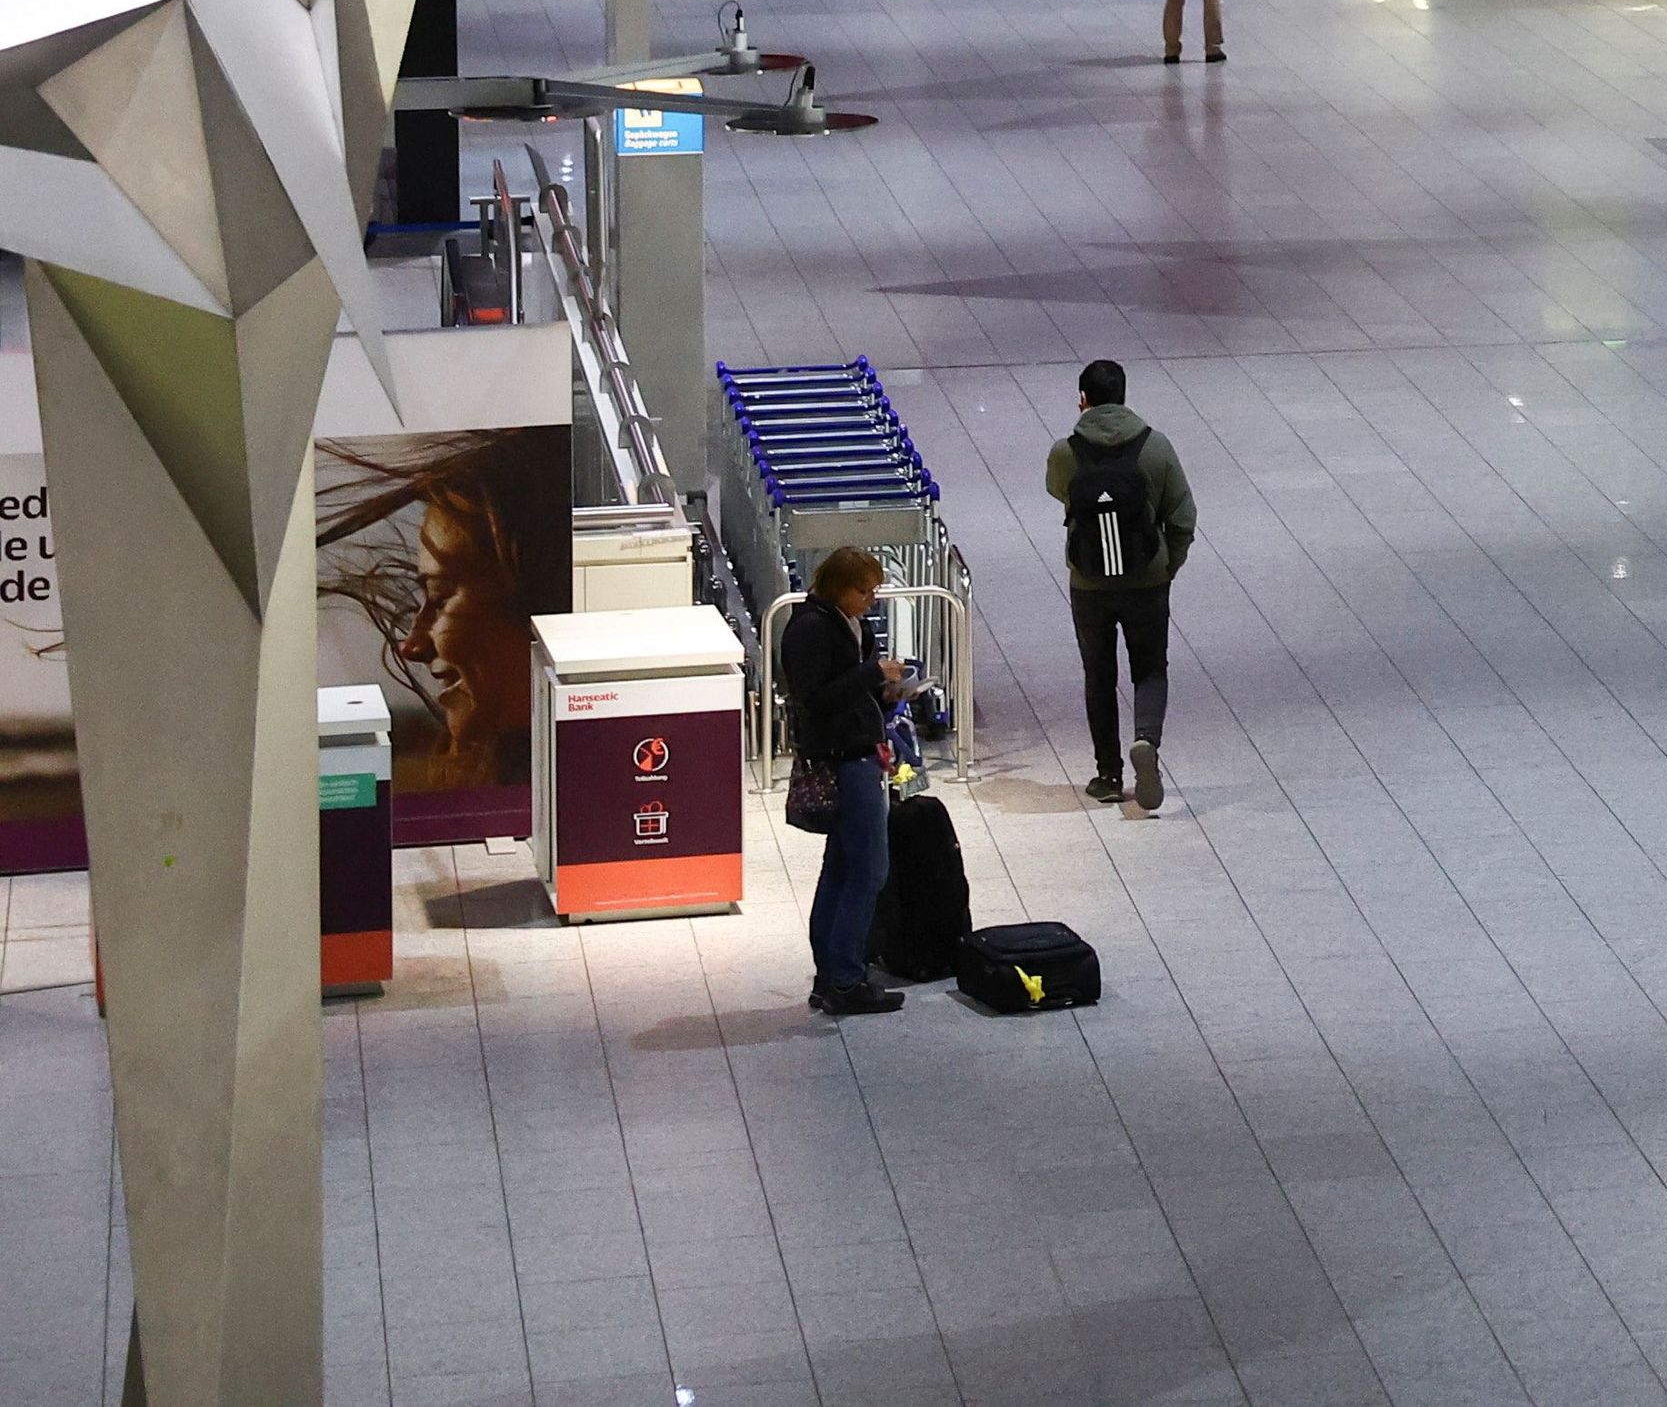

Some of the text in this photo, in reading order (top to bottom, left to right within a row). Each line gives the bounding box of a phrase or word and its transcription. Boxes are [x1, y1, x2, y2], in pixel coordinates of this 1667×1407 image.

[0, 487, 47, 520] ed
[0, 570, 50, 603] de
[568, 692, 619, 704] Hanseatic
[568, 702, 594, 712] Bank
